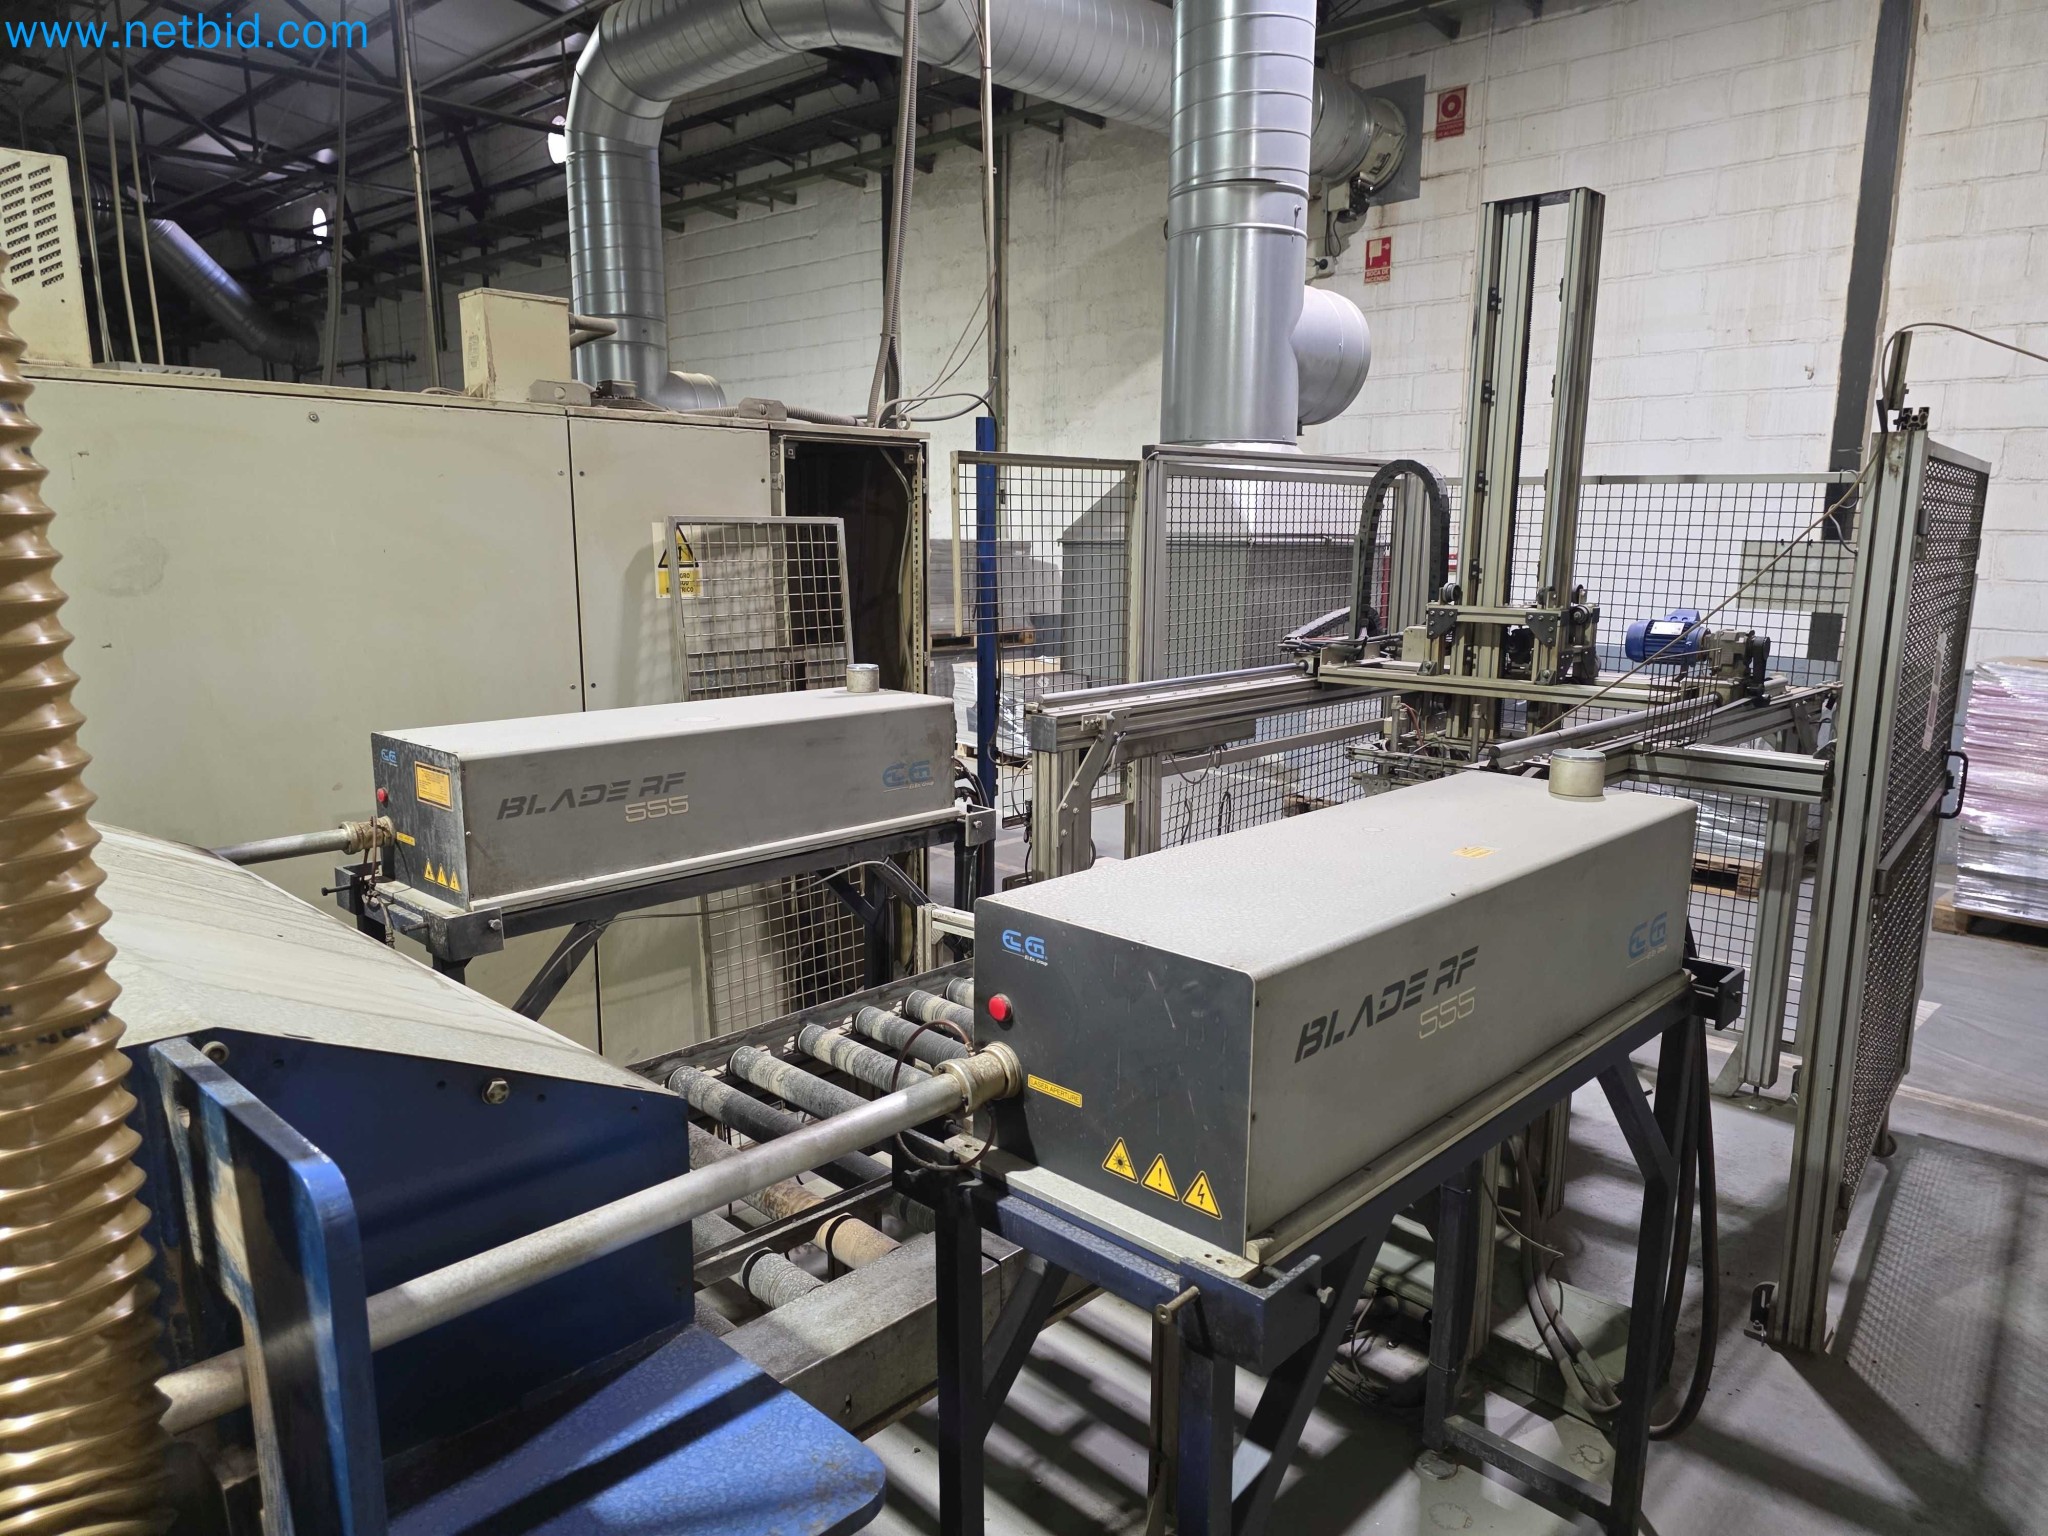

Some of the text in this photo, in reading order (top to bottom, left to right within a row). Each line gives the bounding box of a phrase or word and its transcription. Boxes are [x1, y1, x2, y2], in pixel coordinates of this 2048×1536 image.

[497, 771, 686, 820] BLADE RF
[625, 794, 689, 822] 555
[1294, 945, 1480, 1064] BLADE RF
[1418, 986, 1477, 1040] 555
[1030, 1077, 1080, 1101] LASER APERTURE
